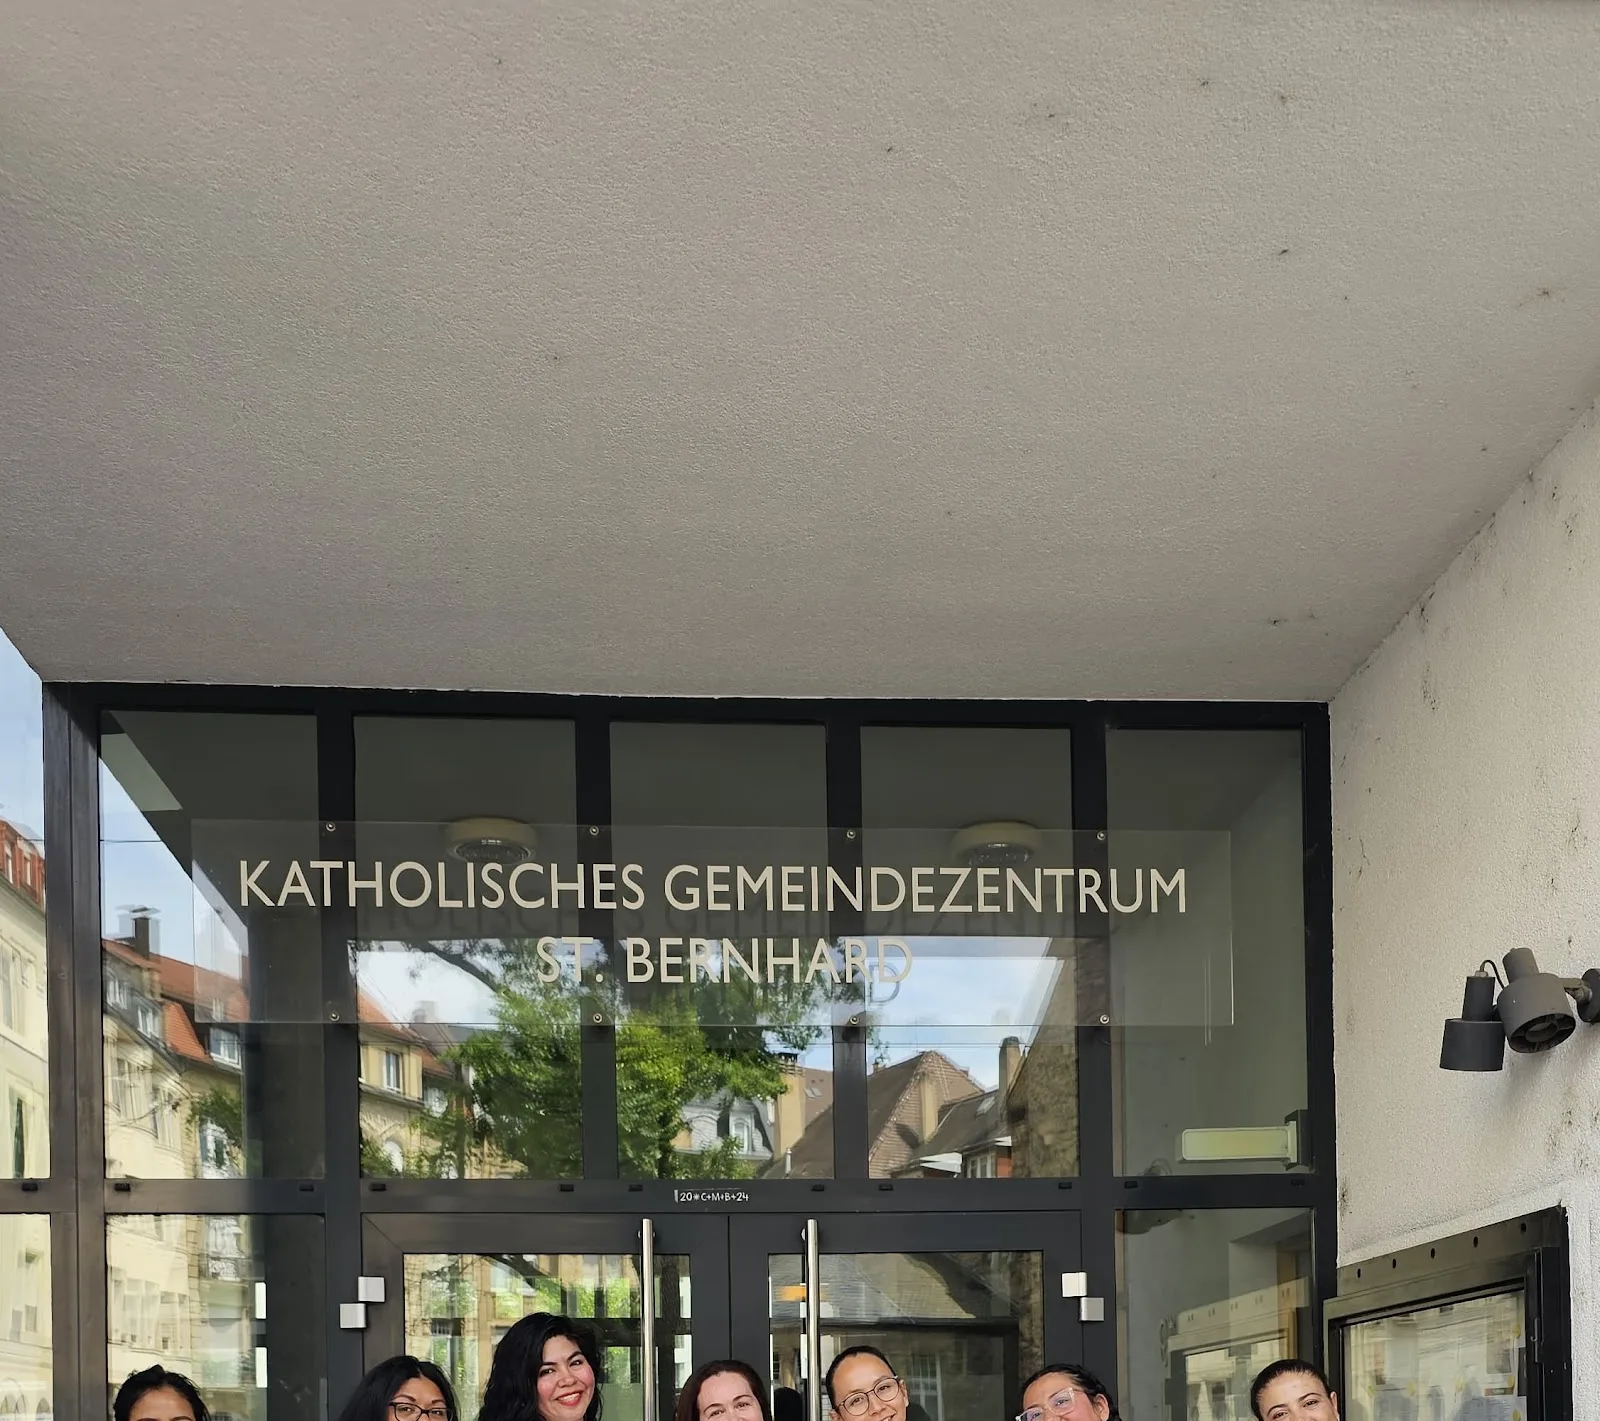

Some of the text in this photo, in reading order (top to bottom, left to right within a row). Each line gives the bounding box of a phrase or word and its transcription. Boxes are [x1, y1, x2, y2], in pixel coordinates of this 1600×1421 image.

[240, 859, 1187, 914] KATHOLISCHES GEMEINDEZENTRUM
[536, 936, 913, 984] ST. BERNHARD
